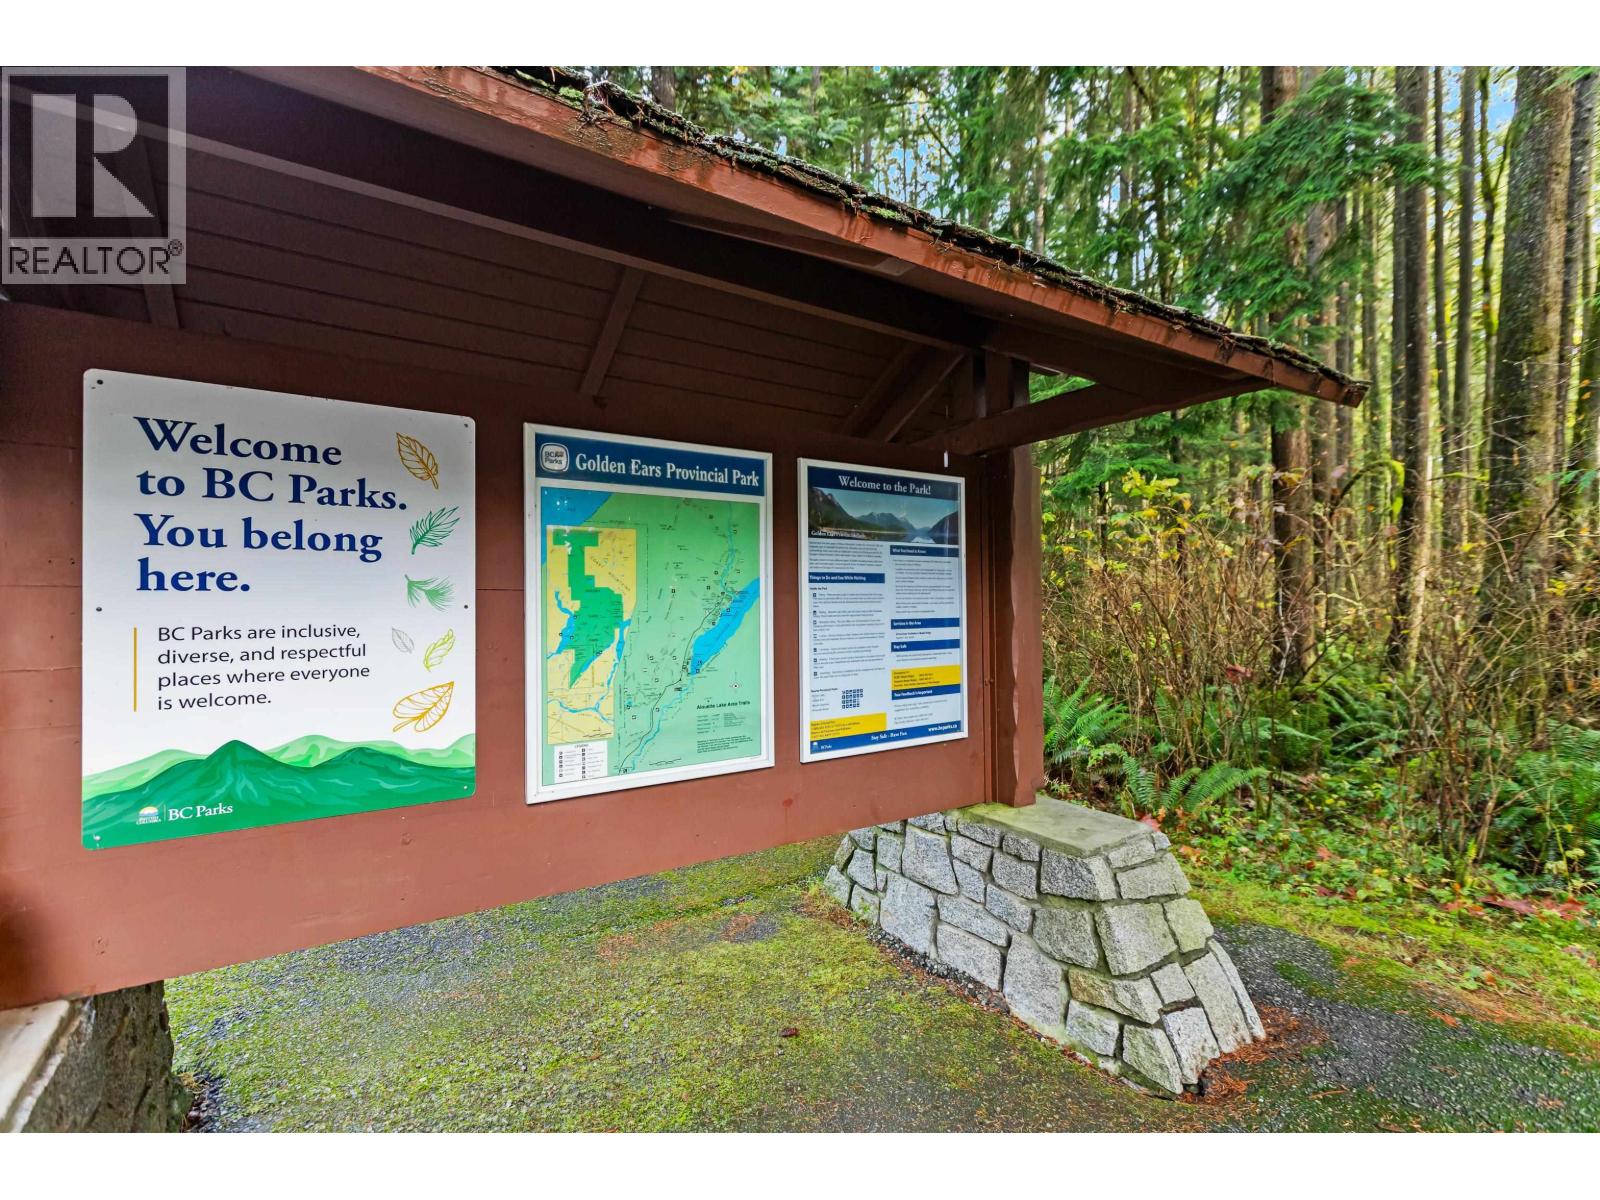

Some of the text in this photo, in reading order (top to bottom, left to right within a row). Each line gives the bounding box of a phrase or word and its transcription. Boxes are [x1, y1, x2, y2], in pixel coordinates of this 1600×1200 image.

[133, 416, 342, 466] Welcome
[544, 457, 563, 465] Parks
[545, 450, 555, 458] BC
[575, 453, 759, 487] Golden Ears Provincial Park
[136, 467, 407, 510] to BC Parks.
[838, 474, 931, 495] Welcome to the Park!
[133, 513, 383, 563] You belong
[136, 557, 251, 592] here.
[158, 623, 361, 642] BC Parks are inclusive,
[157, 643, 366, 665] diverse, and respectful
[157, 665, 370, 691] places where everyone
[157, 691, 271, 711] is welcome.
[168, 803, 233, 821] BC Parks
